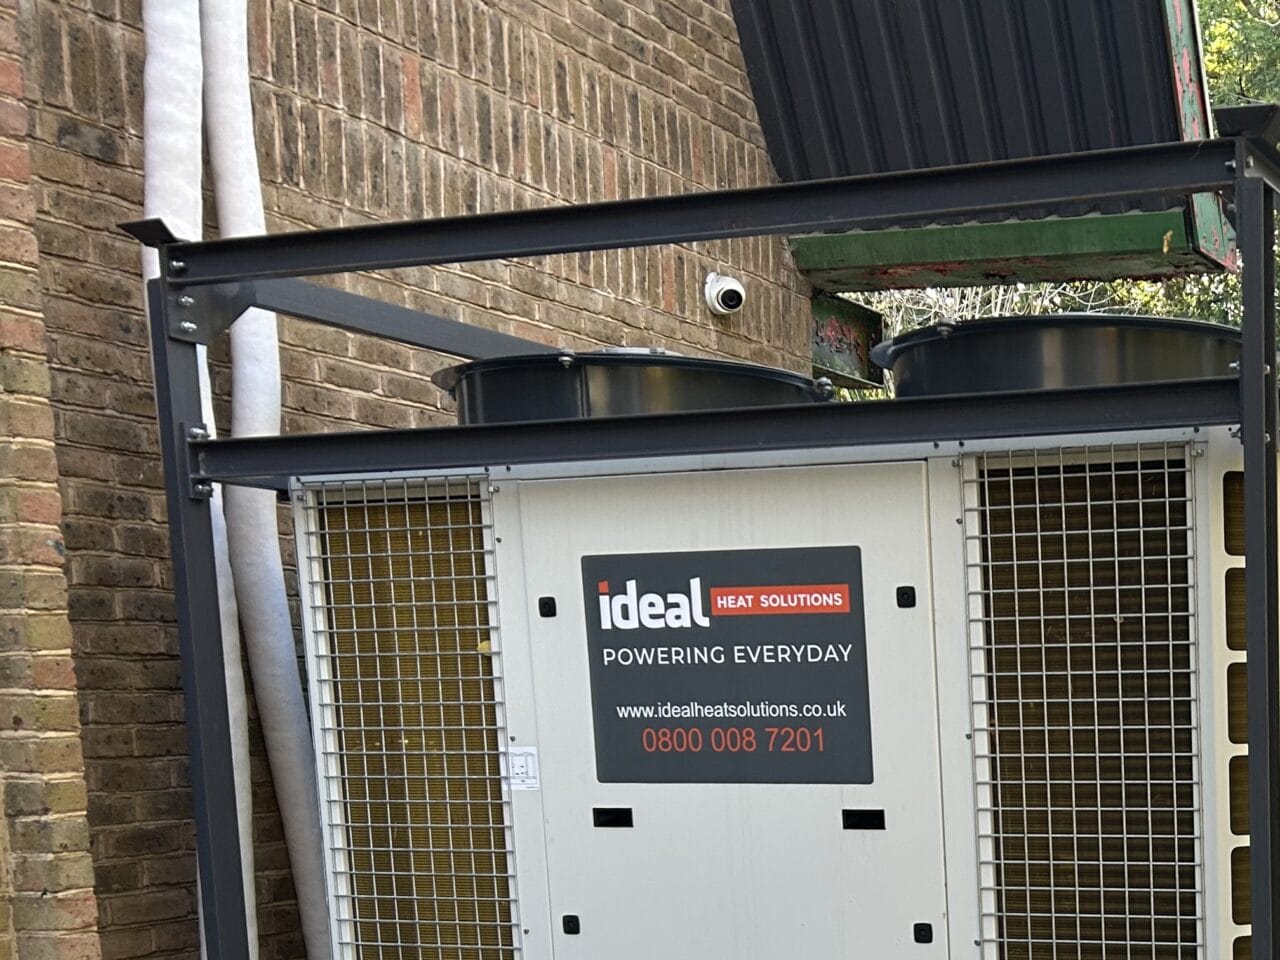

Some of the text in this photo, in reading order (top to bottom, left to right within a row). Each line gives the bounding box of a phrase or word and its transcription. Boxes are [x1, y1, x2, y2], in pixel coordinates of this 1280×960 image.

[598, 577, 710, 630] ideal
[716, 592, 843, 609] HEAT SOLUTIONS
[603, 644, 852, 666] POWERING EVERYDAY
[616, 700, 847, 718] www.idealheatsolutions.co.uk
[642, 727, 825, 752] 0800 008 7201
